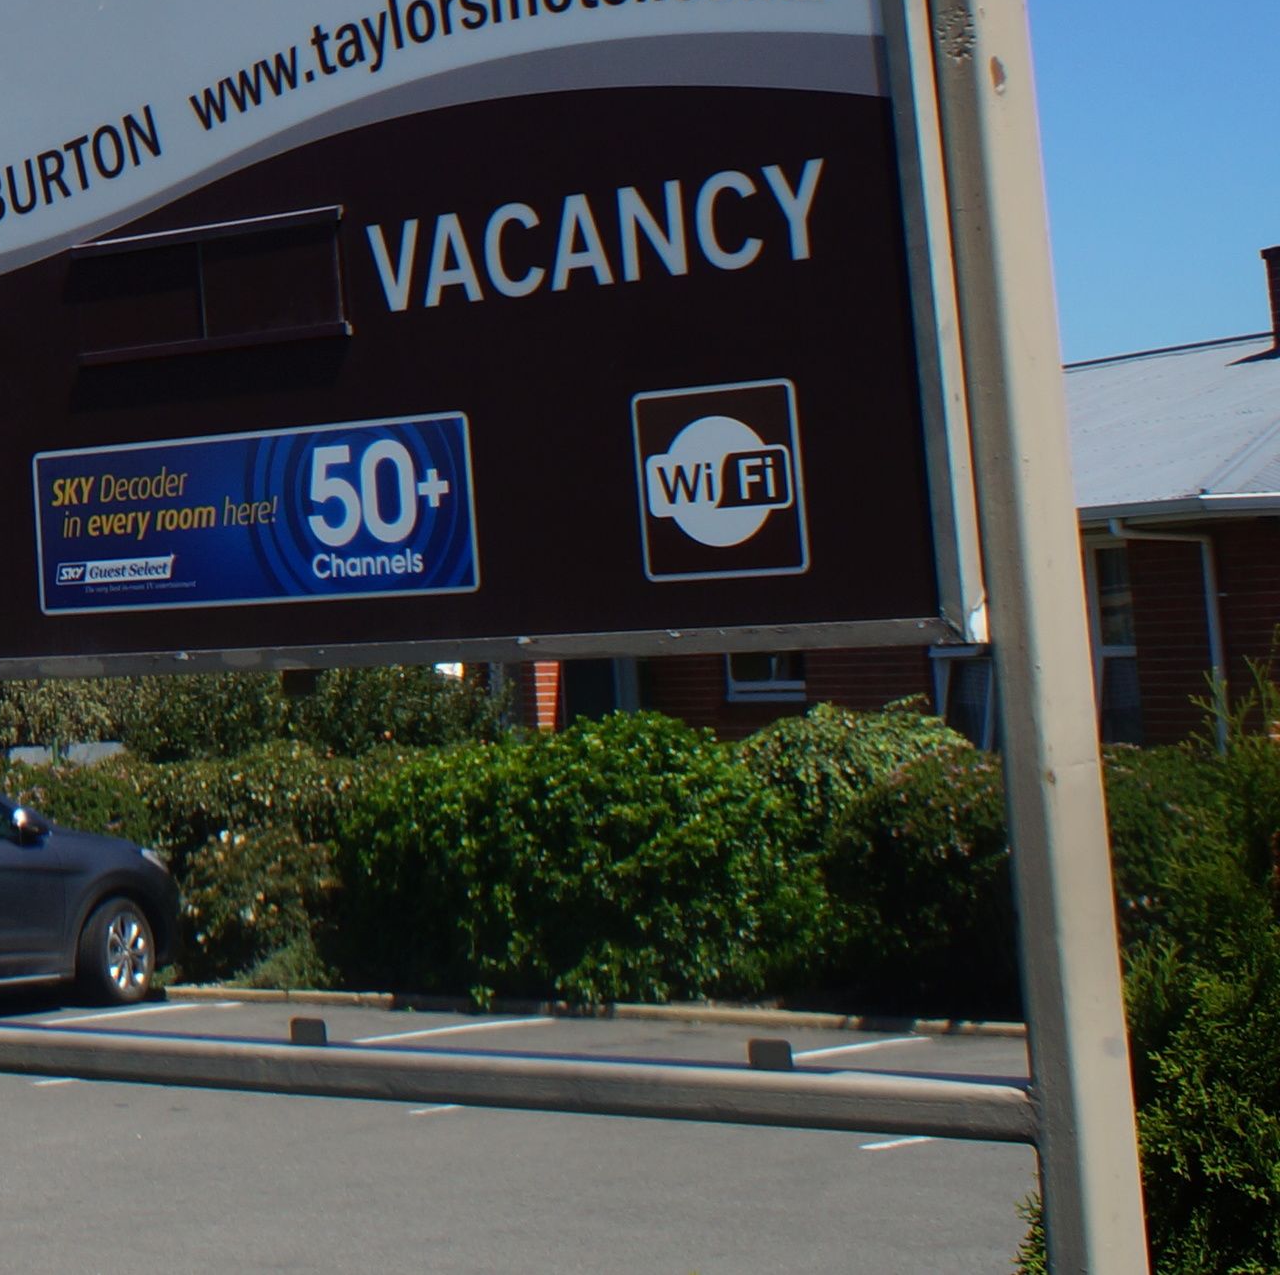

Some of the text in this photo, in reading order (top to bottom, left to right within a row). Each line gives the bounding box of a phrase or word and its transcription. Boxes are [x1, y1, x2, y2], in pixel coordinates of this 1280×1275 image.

[365, 157, 825, 313] VACANCY
[51, 465, 189, 507] SKY Decoder
[308, 438, 450, 548] 50+
[62, 495, 279, 541] in every room here!
[89, 564, 127, 580] Guest
[127, 560, 169, 577] Select
[312, 548, 425, 580] Channels
